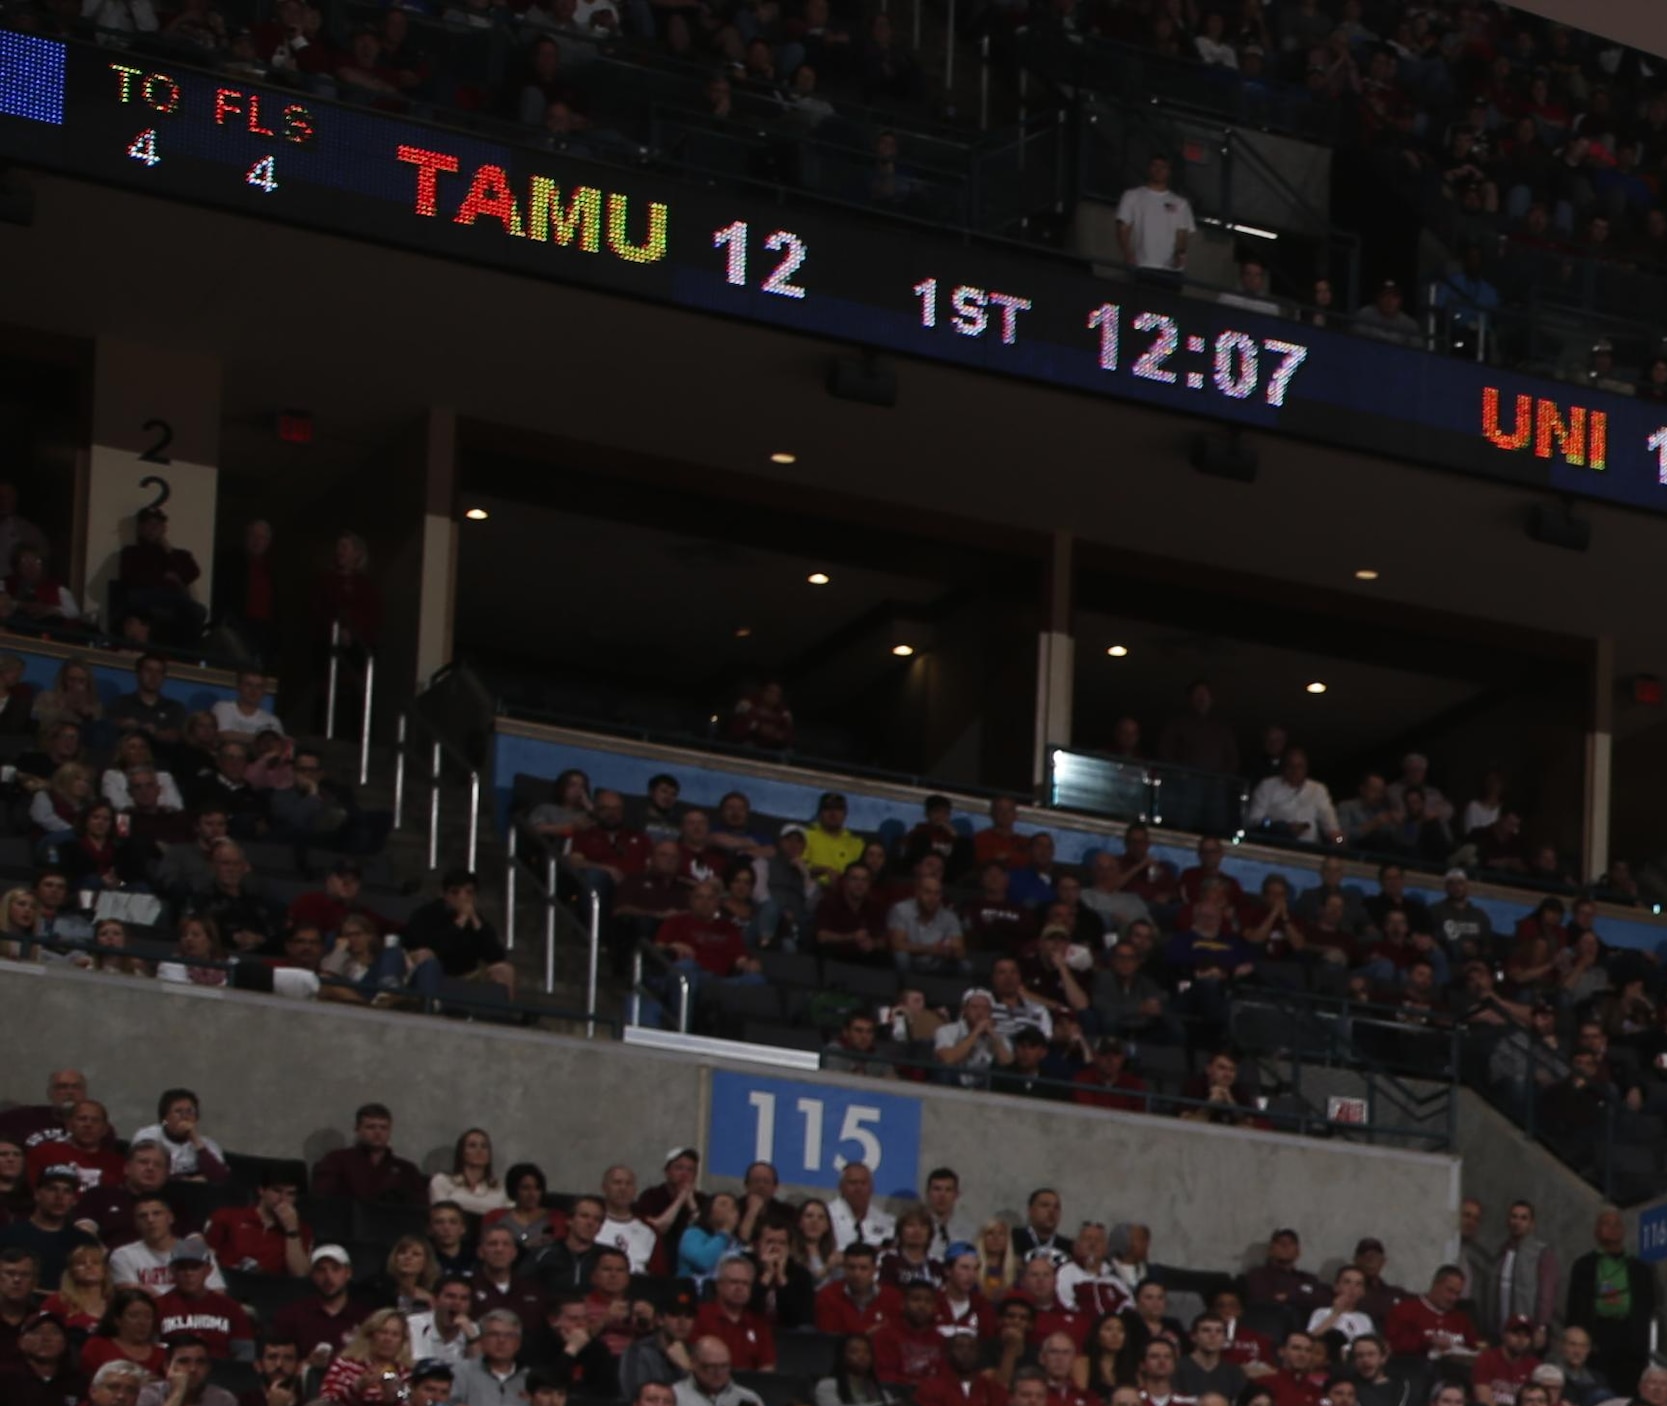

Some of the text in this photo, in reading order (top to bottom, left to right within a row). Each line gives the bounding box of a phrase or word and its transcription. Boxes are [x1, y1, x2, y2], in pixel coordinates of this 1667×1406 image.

[108, 63, 314, 144] TO FLS
[127, 127, 279, 192] 4 4
[397, 143, 668, 265] TAMU
[713, 219, 807, 300] 12
[914, 278, 1031, 344] 1ST
[1088, 303, 1308, 407] 12:07
[1481, 386, 1607, 471] UNI
[749, 1090, 882, 1173] 115
